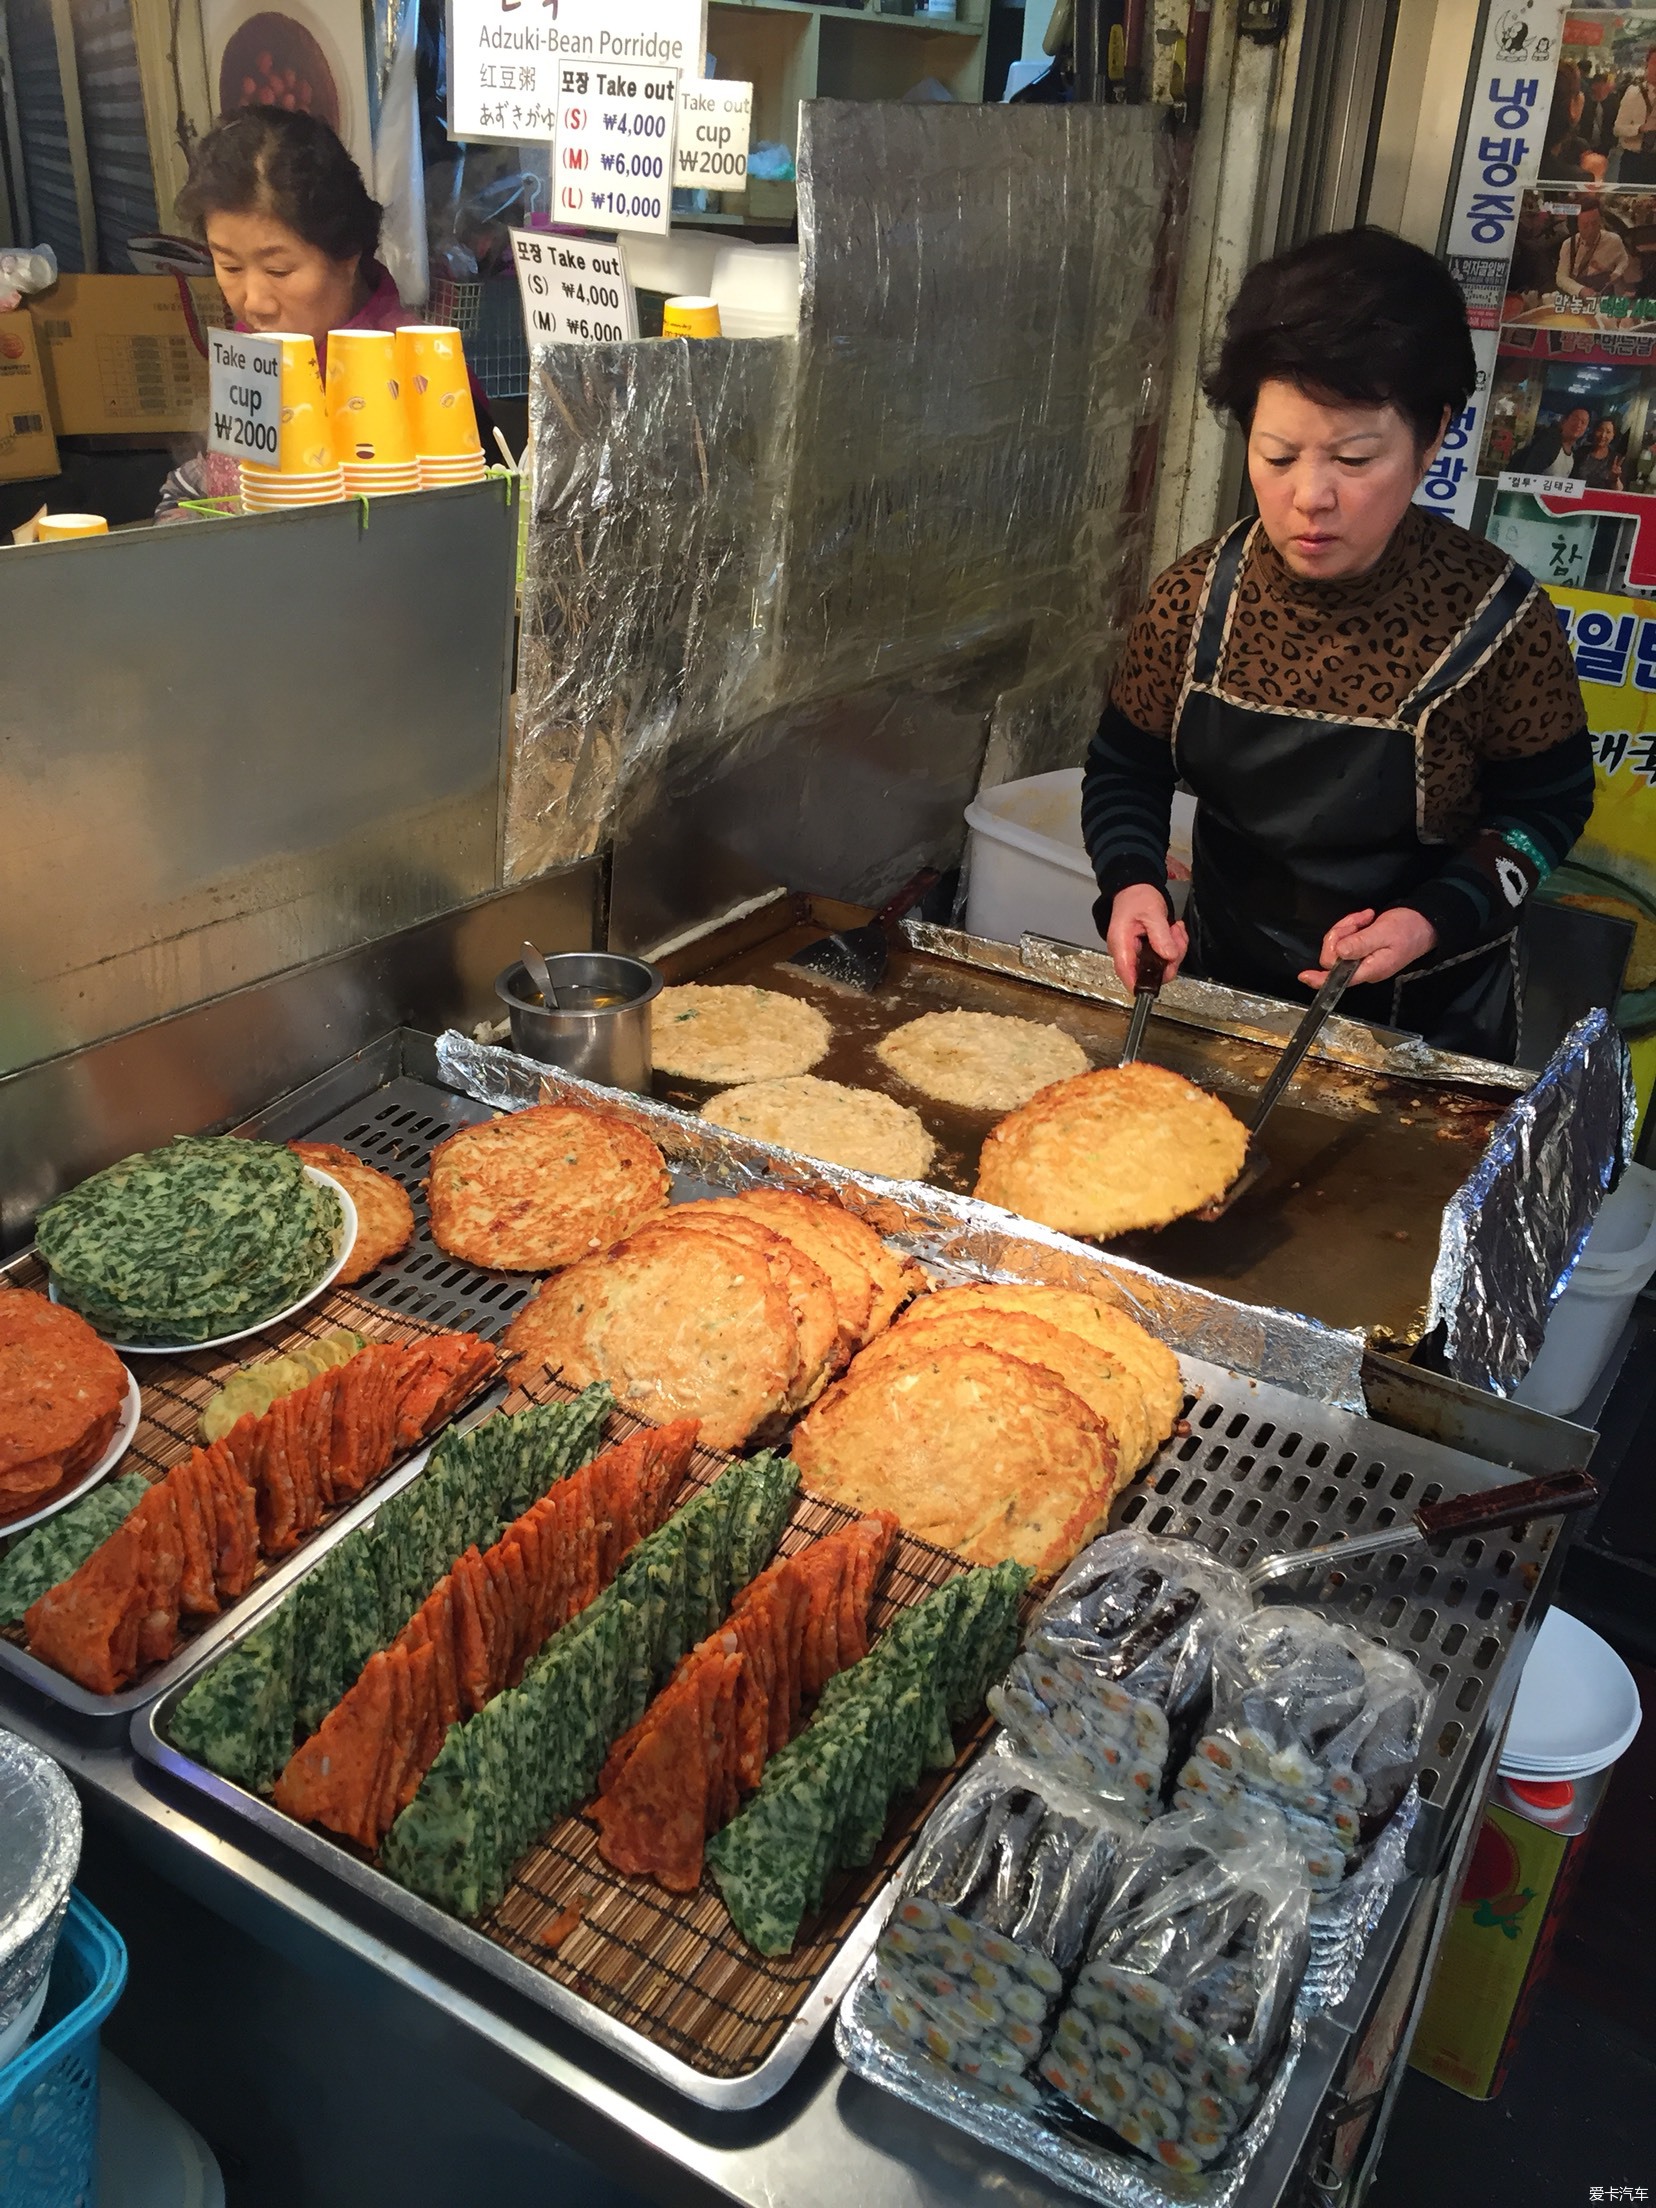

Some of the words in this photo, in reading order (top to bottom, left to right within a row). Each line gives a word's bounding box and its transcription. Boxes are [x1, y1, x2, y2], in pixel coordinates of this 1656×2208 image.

[479, 25, 593, 54] Adzuki-Bean
[600, 31, 683, 63] Porridge
[480, 63, 536, 91] 红豆粥
[561, 71, 589, 95] 포장
[597, 74, 637, 97] Take
[644, 81, 675, 101] out
[480, 101, 555, 131] あずきがゆ
[681, 93, 715, 112] Take
[723, 98, 750, 114] out
[564, 108, 587, 131] (S)
[603, 113, 666, 138] ₩4,000
[696, 125, 731, 149] cup
[562, 148, 589, 170] (M)
[601, 153, 663, 179] ₩6,000
[679, 149, 746, 176] ₩2000
[1466, 78, 1539, 244] 냉방중
[561, 187, 583, 209] (L)
[591, 192, 661, 219] ₩10,000
[517, 241, 542, 264] 포장
[547, 246, 586, 270] Take
[592, 258, 620, 276] out
[527, 273, 549, 296] (S)
[561, 282, 619, 309] ₩4,000
[532, 309, 557, 333] (M)
[213, 342, 246, 370] Take
[253, 357, 279, 377] out
[229, 385, 262, 417] cup
[214, 412, 278, 453] ₩2000
[1543, 480, 1573, 494] 김태균
